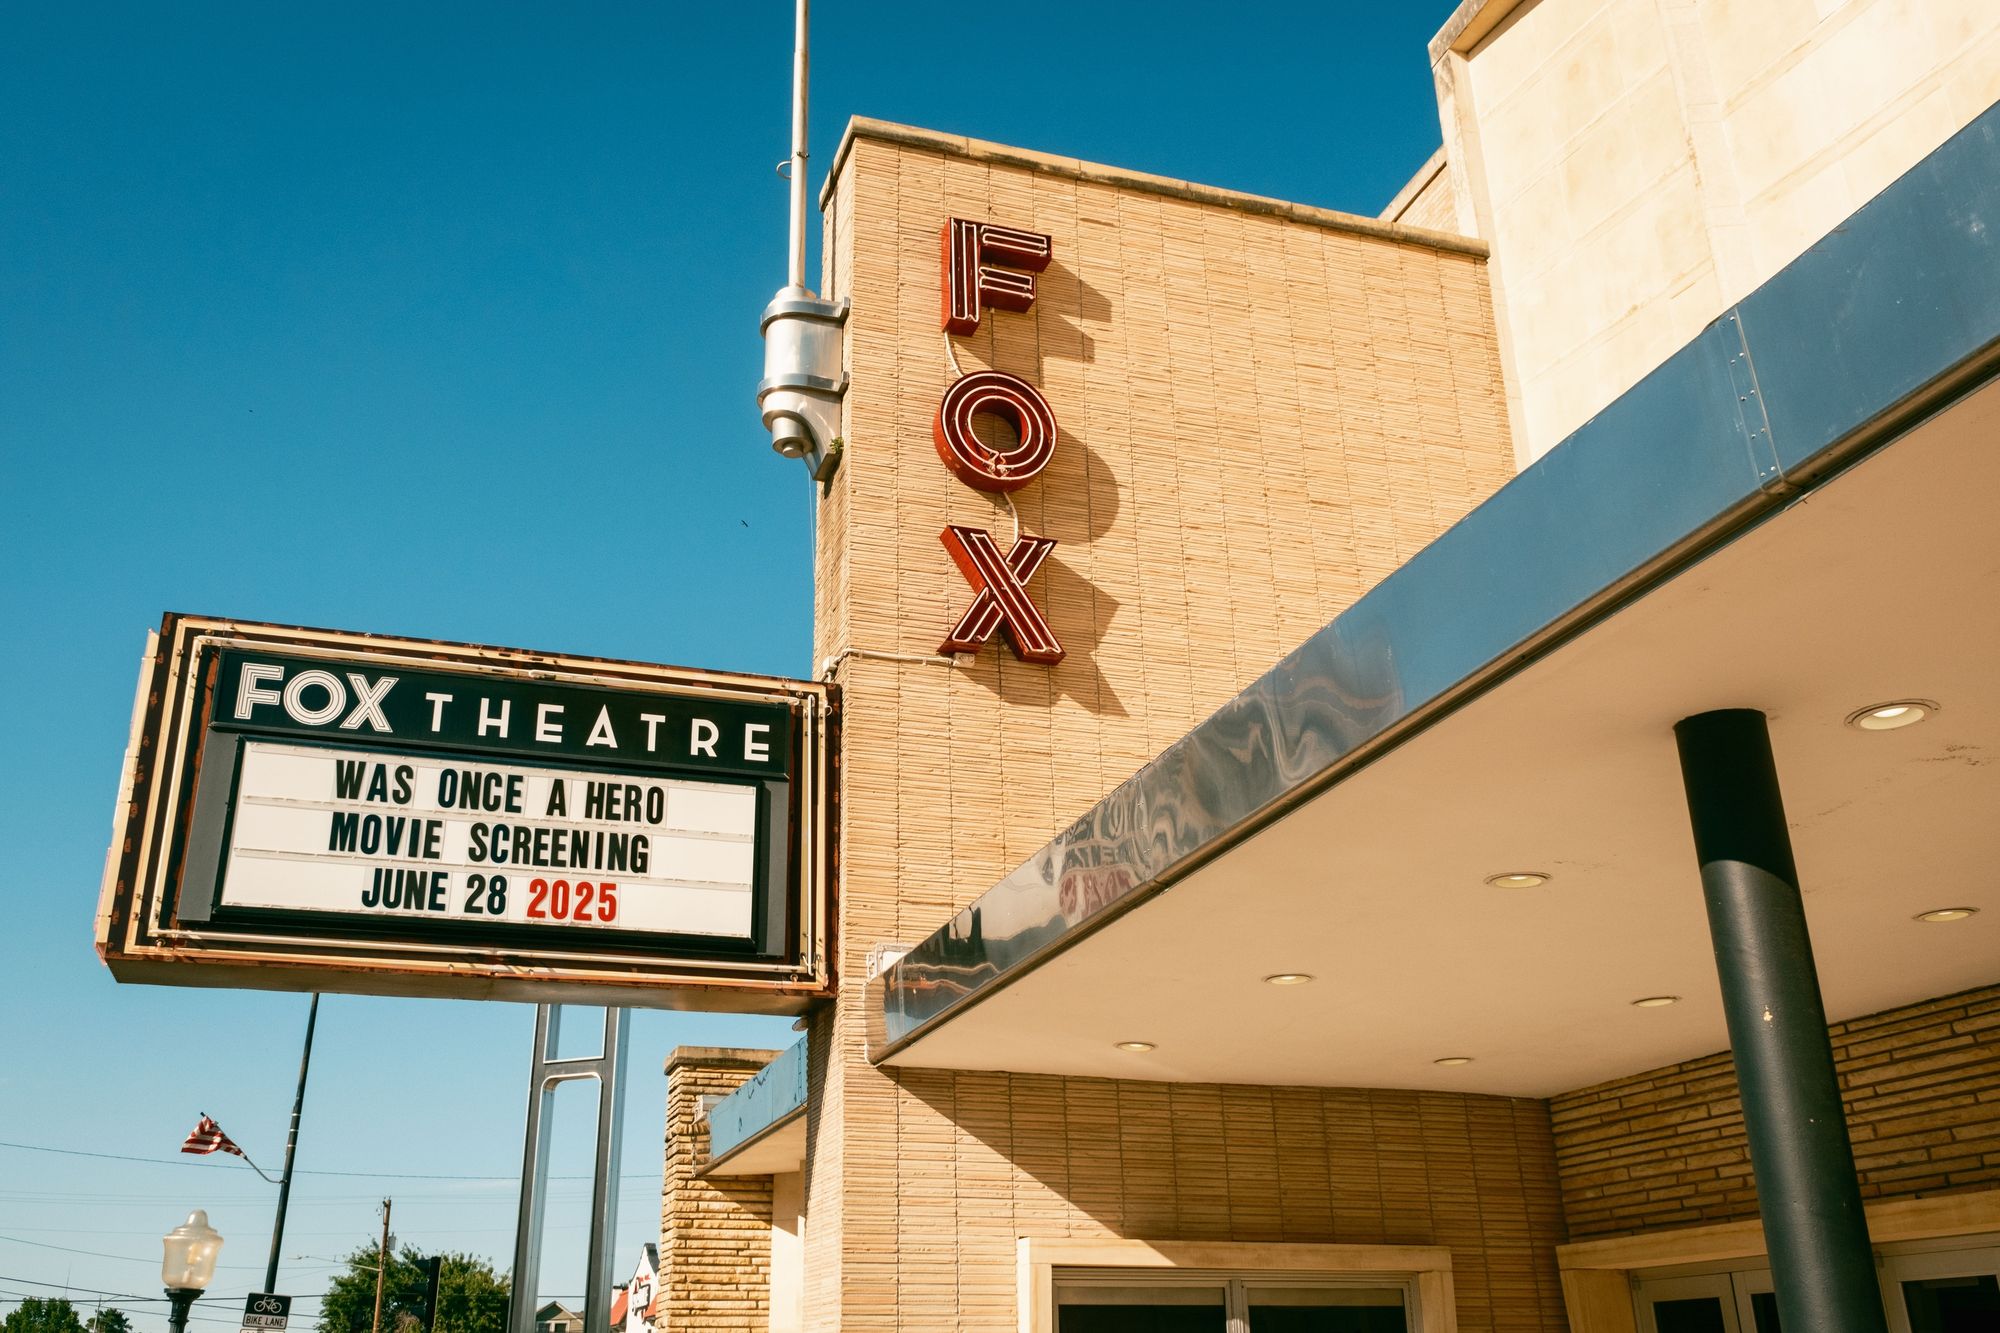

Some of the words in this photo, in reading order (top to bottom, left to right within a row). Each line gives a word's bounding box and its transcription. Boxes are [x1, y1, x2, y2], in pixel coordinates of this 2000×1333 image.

[933, 217, 1067, 666] FOX
[234, 662, 400, 733] FOX
[425, 692, 770, 762] THEATRE
[335, 759, 414, 805] WAS
[437, 768, 524, 814] ONCE
[546, 778, 567, 817] A
[584, 781, 665, 825] HERO
[328, 811, 443, 860] MOVIE
[468, 822, 650, 874] SCREENING
[361, 867, 449, 912] JUNE
[463, 873, 508, 915] 28
[526, 878, 617, 922] 2025
[245, 1315, 263, 1325] BIKE
[264, 1316, 285, 1327] LANE
